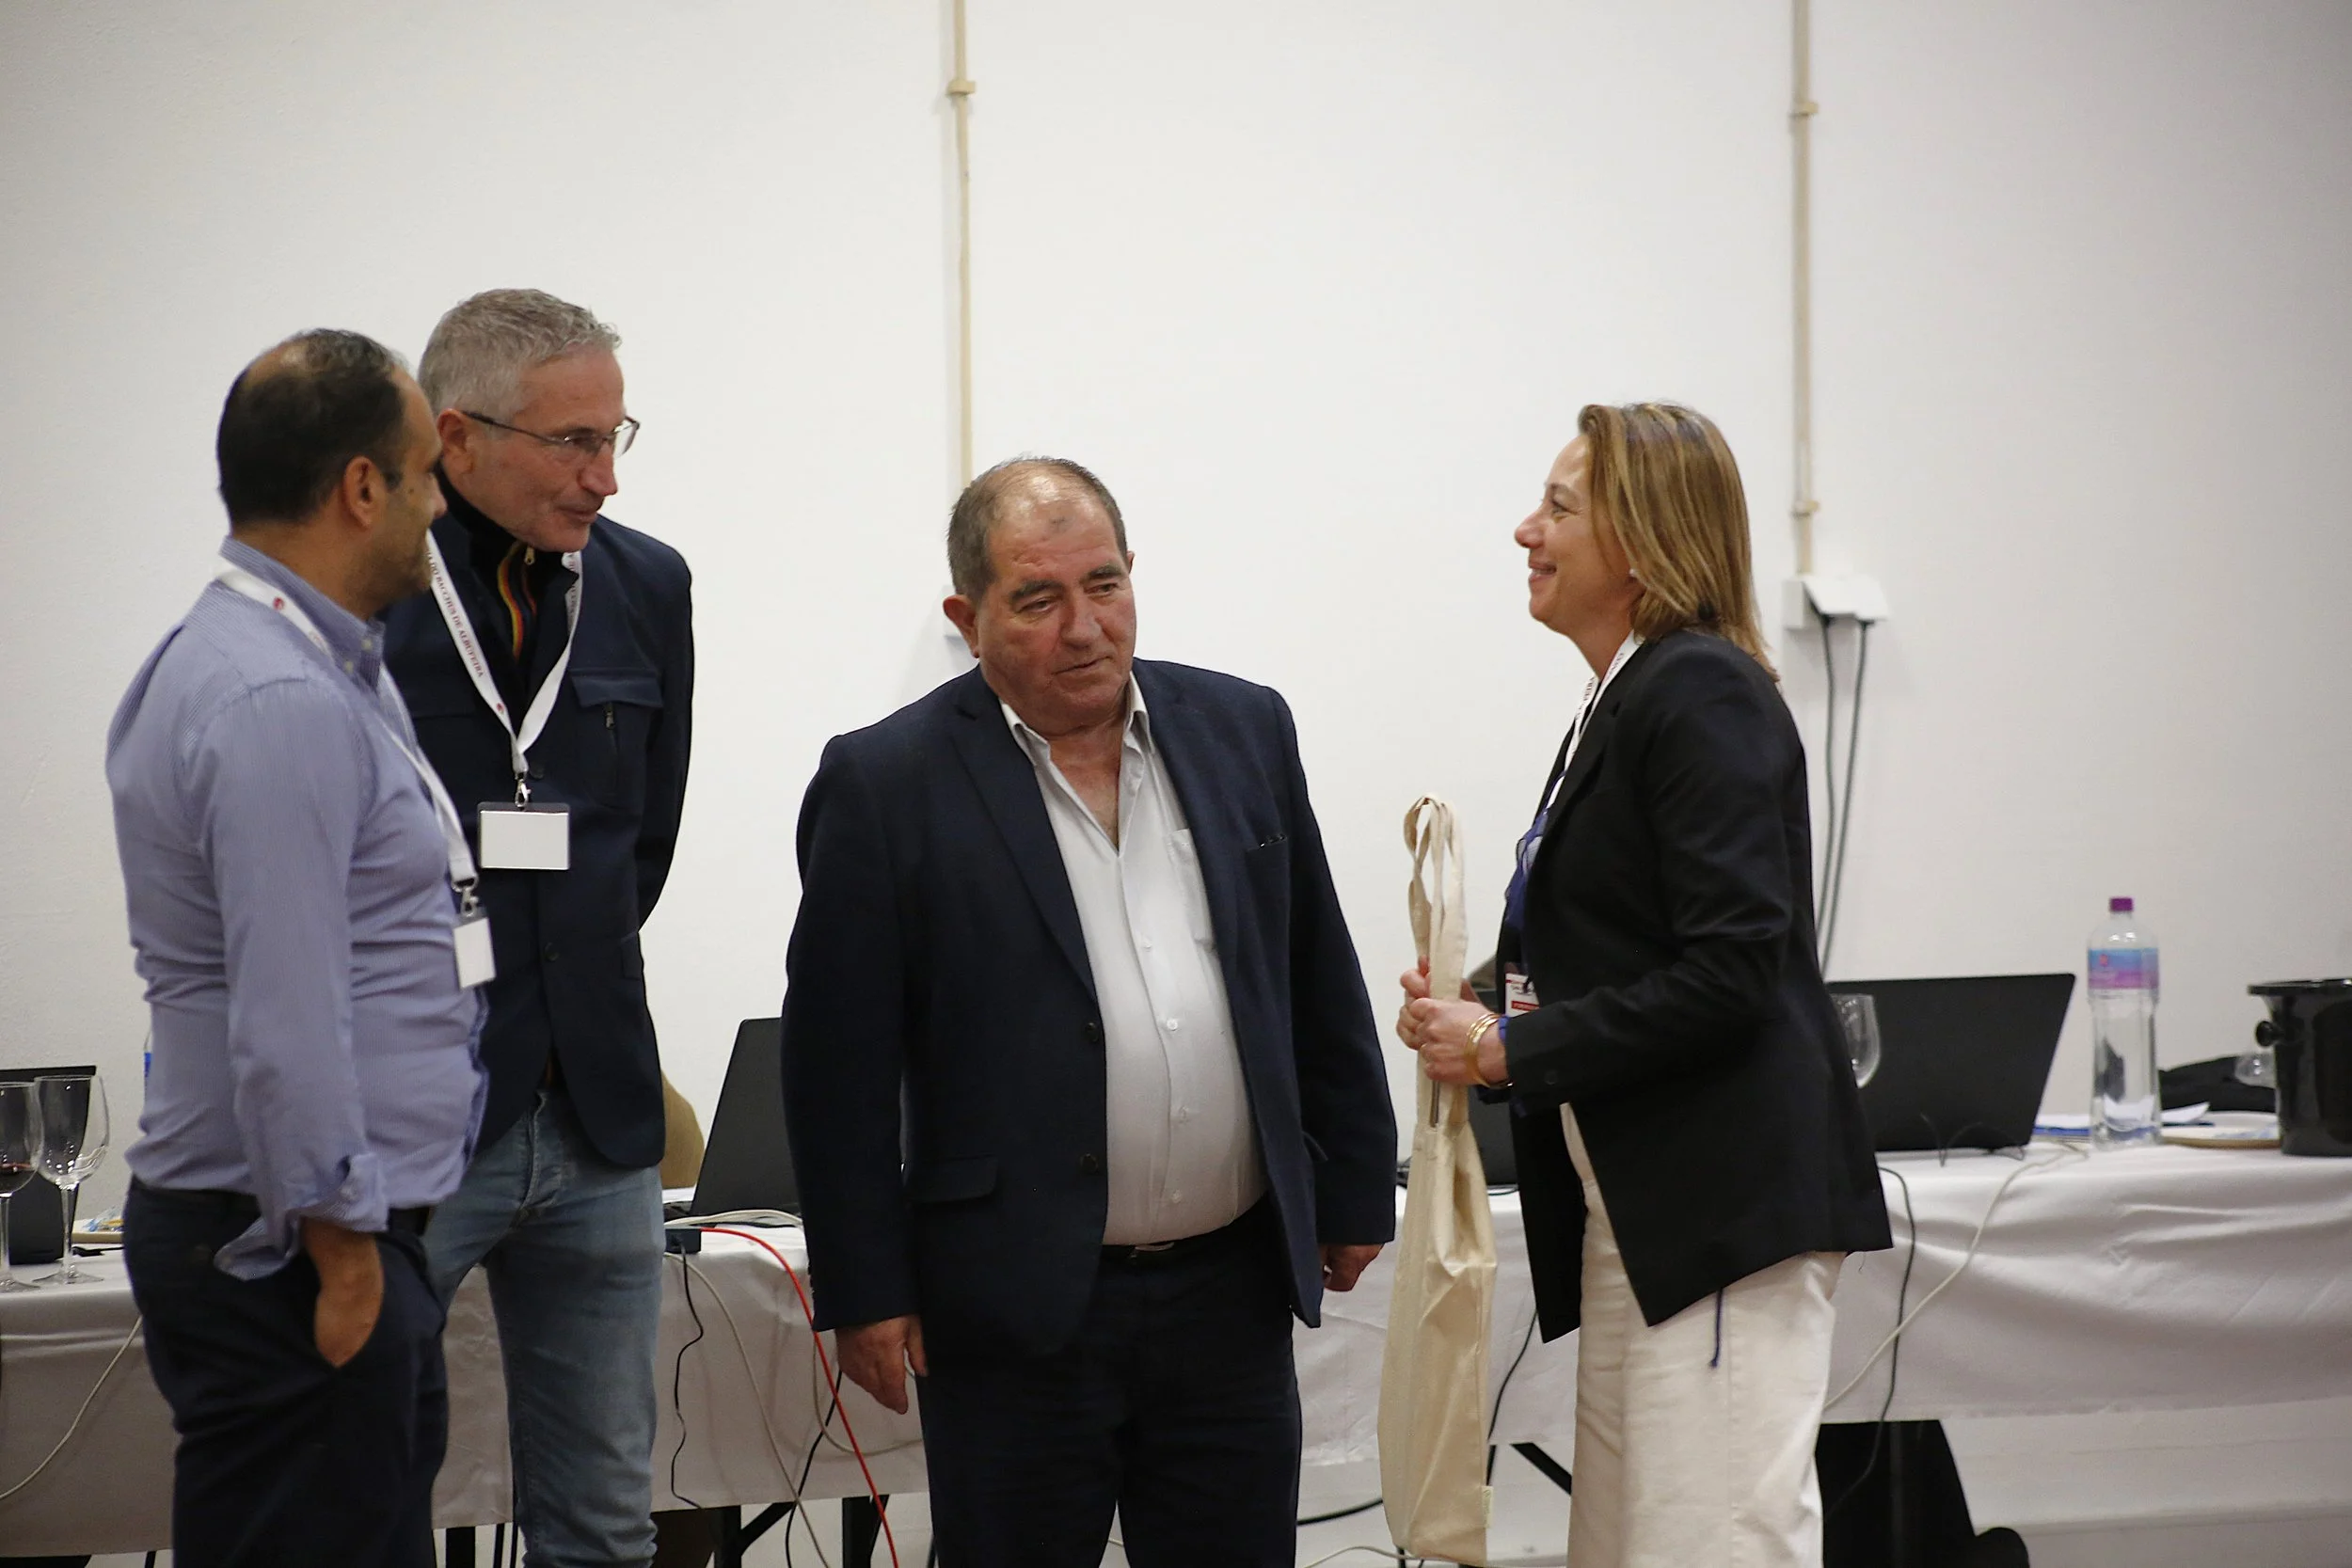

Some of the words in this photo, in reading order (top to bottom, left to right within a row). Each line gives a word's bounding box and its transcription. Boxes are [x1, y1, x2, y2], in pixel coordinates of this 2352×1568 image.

[436, 576, 456, 615] BACCHUS
[452, 615, 463, 629] DE
[458, 629, 484, 677] ALBUFEIRA
